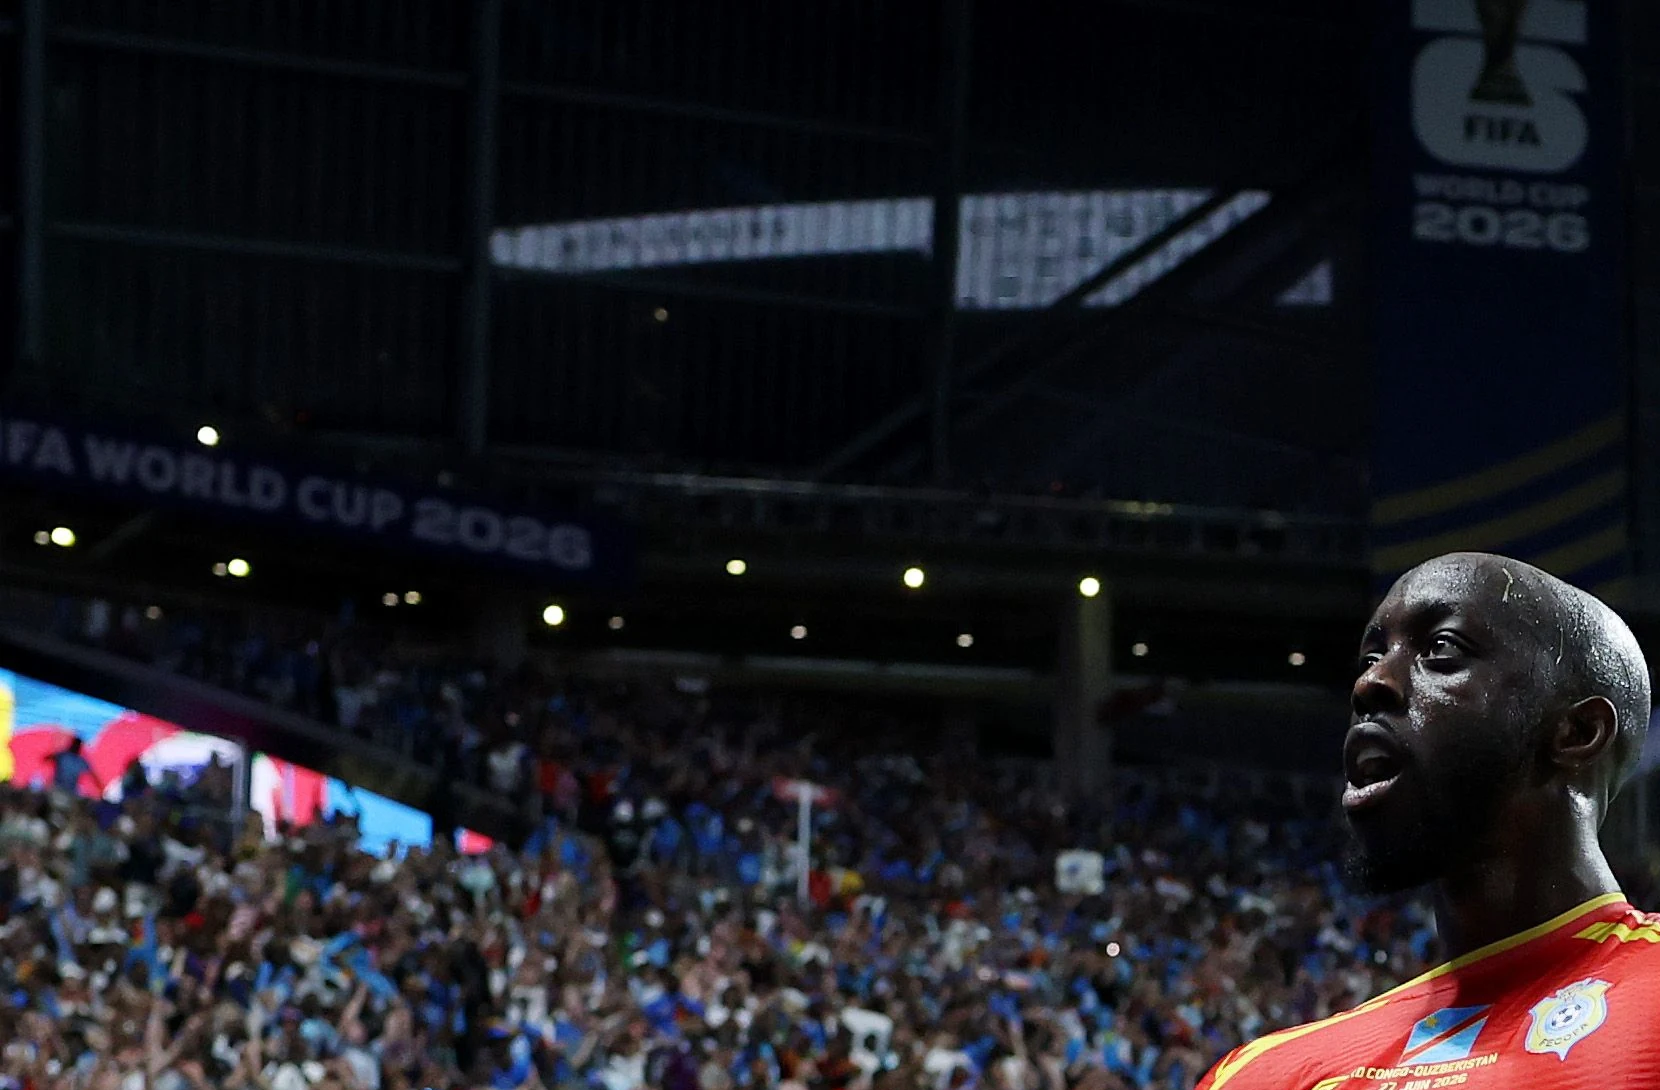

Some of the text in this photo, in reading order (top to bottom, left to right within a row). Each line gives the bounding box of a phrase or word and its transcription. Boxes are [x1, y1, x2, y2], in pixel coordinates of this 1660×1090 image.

[1463, 114, 1543, 146] FIFA
[1412, 172, 1591, 208] WORLD CUP
[1411, 200, 1590, 252] 2026
[0, 417, 593, 571] FA WORLD CUP 2026
[1366, 1053, 1498, 1080] CONGO-OUZBEKISTAN
[1432, 1073, 1468, 1089] 2026
